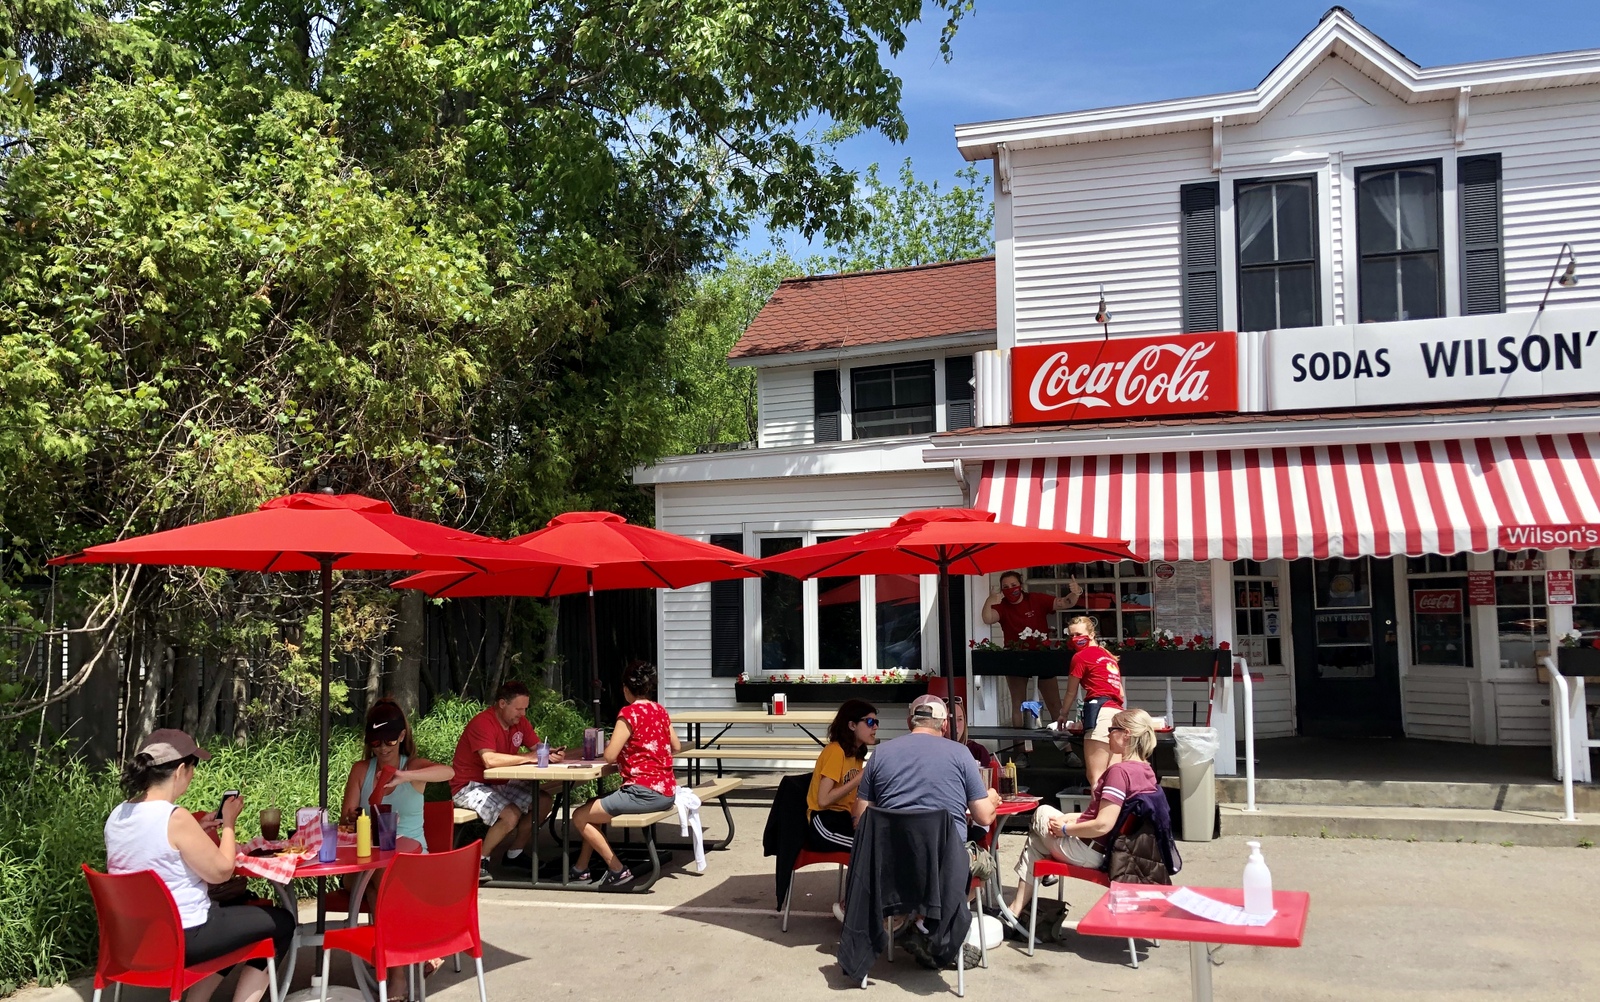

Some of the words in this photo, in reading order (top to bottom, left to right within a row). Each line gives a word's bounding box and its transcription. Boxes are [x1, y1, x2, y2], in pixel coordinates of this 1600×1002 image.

[1029, 341, 1216, 411] Coca-Cola
[1292, 348, 1391, 382] SODAS
[1506, 526, 1599, 544] Wilson's
